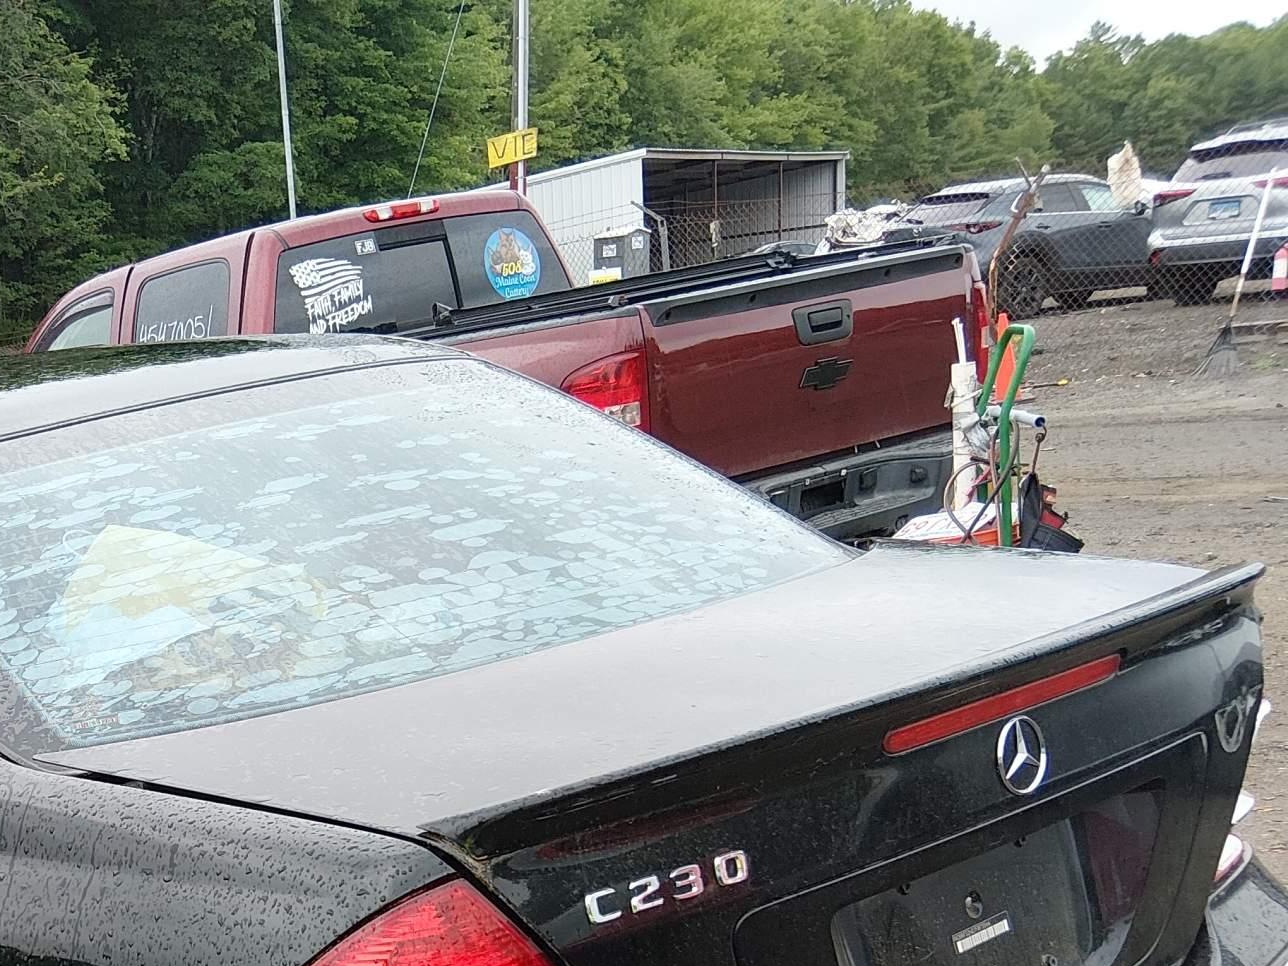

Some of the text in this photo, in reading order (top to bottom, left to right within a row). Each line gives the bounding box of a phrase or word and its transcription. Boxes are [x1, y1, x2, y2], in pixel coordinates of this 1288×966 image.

[333, 279, 364, 306] FAMILY
[326, 295, 373, 332] FREEDOM
[585, 850, 748, 924] C230
